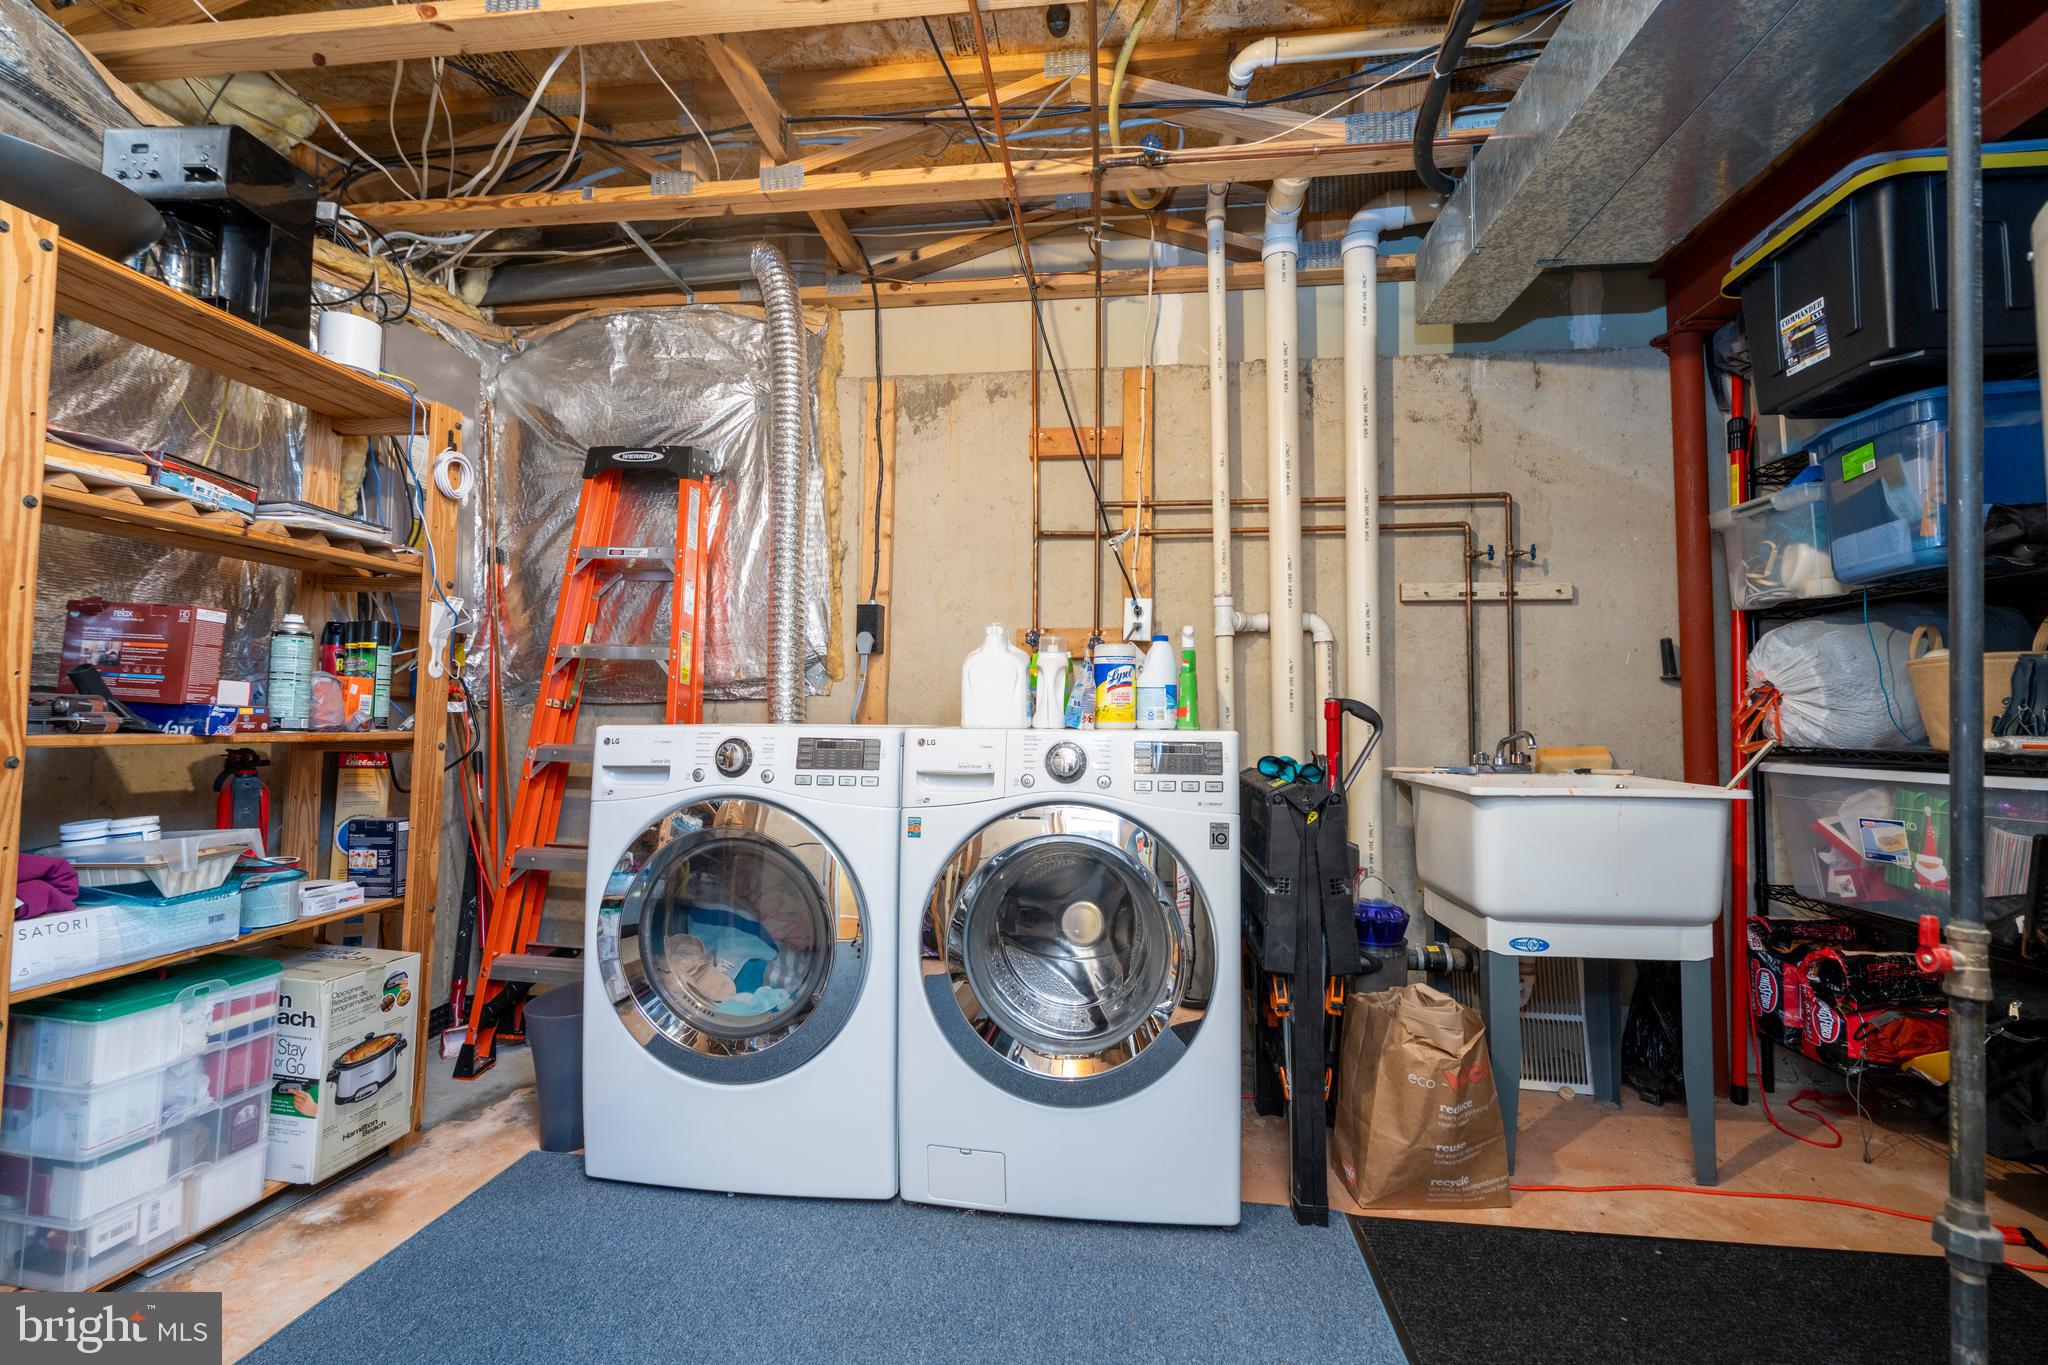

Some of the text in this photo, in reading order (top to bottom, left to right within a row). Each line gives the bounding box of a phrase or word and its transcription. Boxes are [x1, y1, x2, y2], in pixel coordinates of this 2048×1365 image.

[113, 608, 134, 617] relax
[1108, 665, 1133, 684] Lysol
[18, 918, 89, 941] SATORI
[331, 984, 365, 1001] Opciones
[1759, 971, 1774, 1009] KINGSFORD
[277, 1010, 316, 1029] ach
[277, 1038, 307, 1059] Stay
[274, 1057, 306, 1076] or Go
[1408, 1073, 1435, 1088] eco
[1439, 1100, 1473, 1114] reduce
[342, 1119, 378, 1141] Hamilton
[362, 1120, 387, 1137] Beach
[1436, 1142, 1466, 1152] reuse
[1430, 1175, 1469, 1187] recycle
